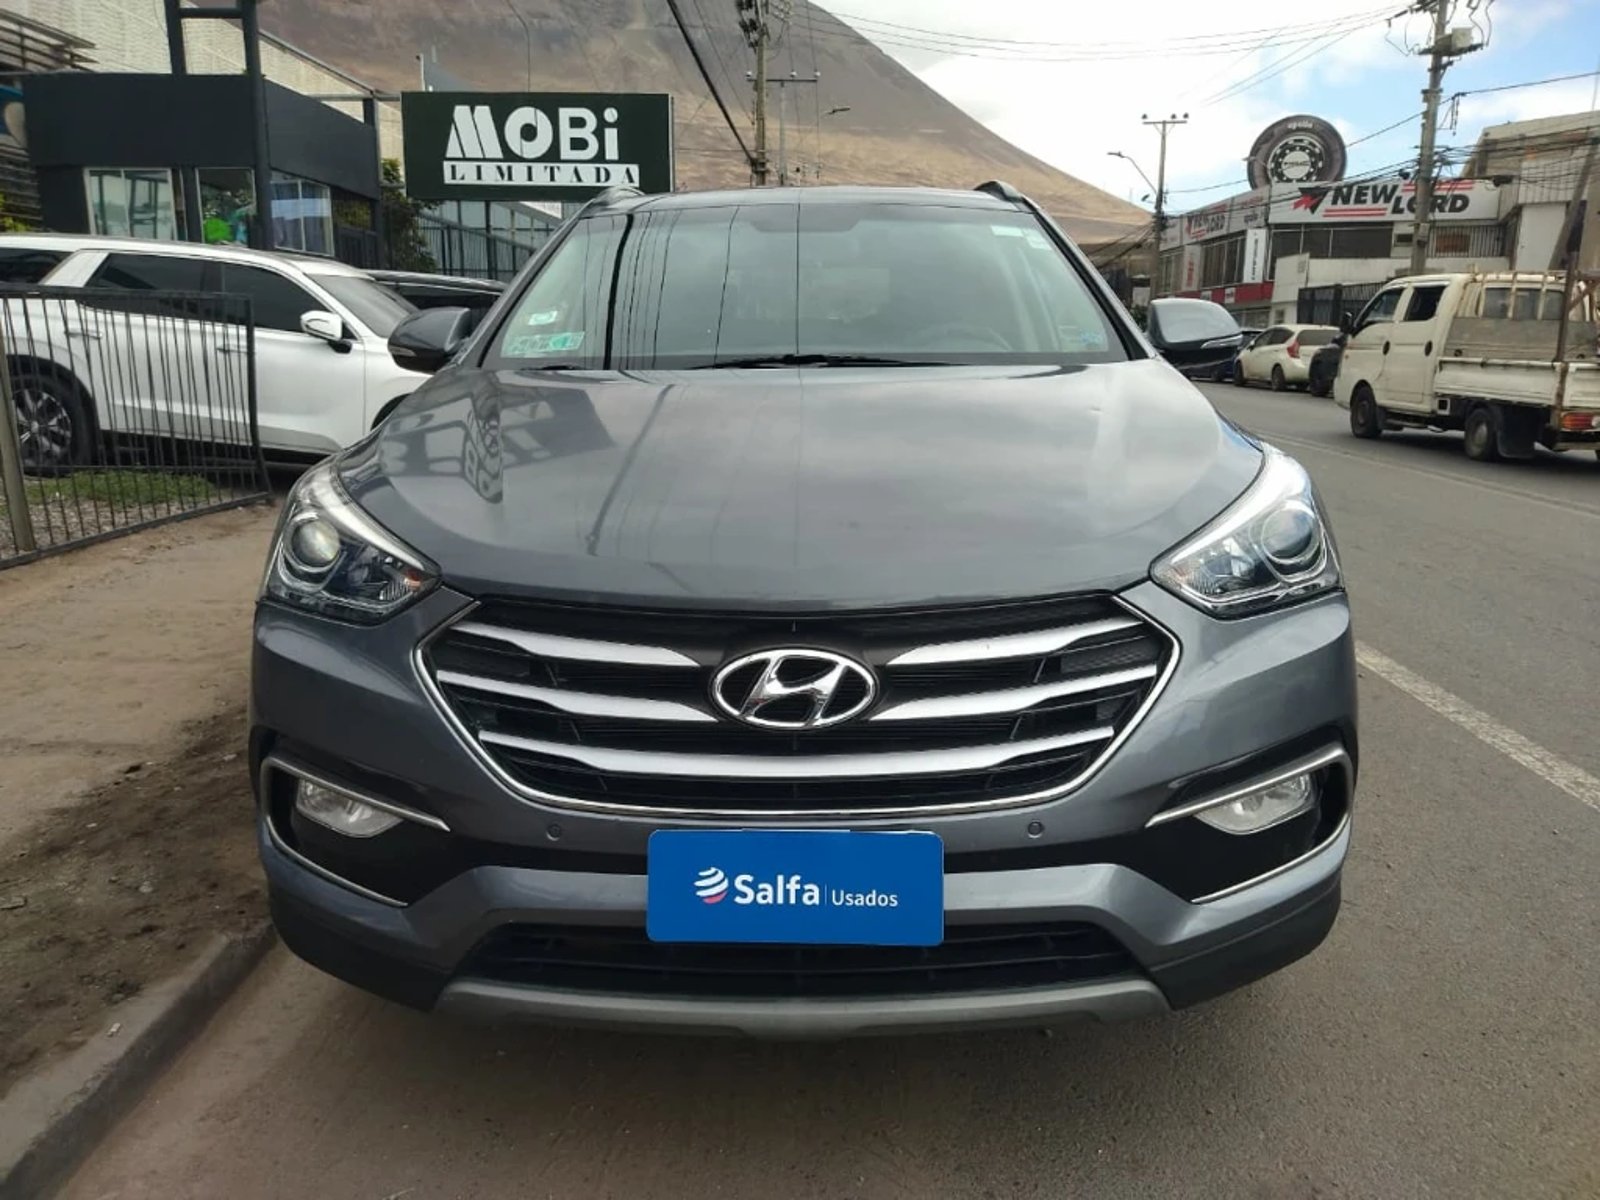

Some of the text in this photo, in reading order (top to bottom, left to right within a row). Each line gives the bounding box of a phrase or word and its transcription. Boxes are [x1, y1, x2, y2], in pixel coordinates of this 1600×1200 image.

[450, 164, 636, 184] LIMITADA
[1331, 184, 1399, 206] NEW
[734, 874, 899, 907] Salfa Usados
